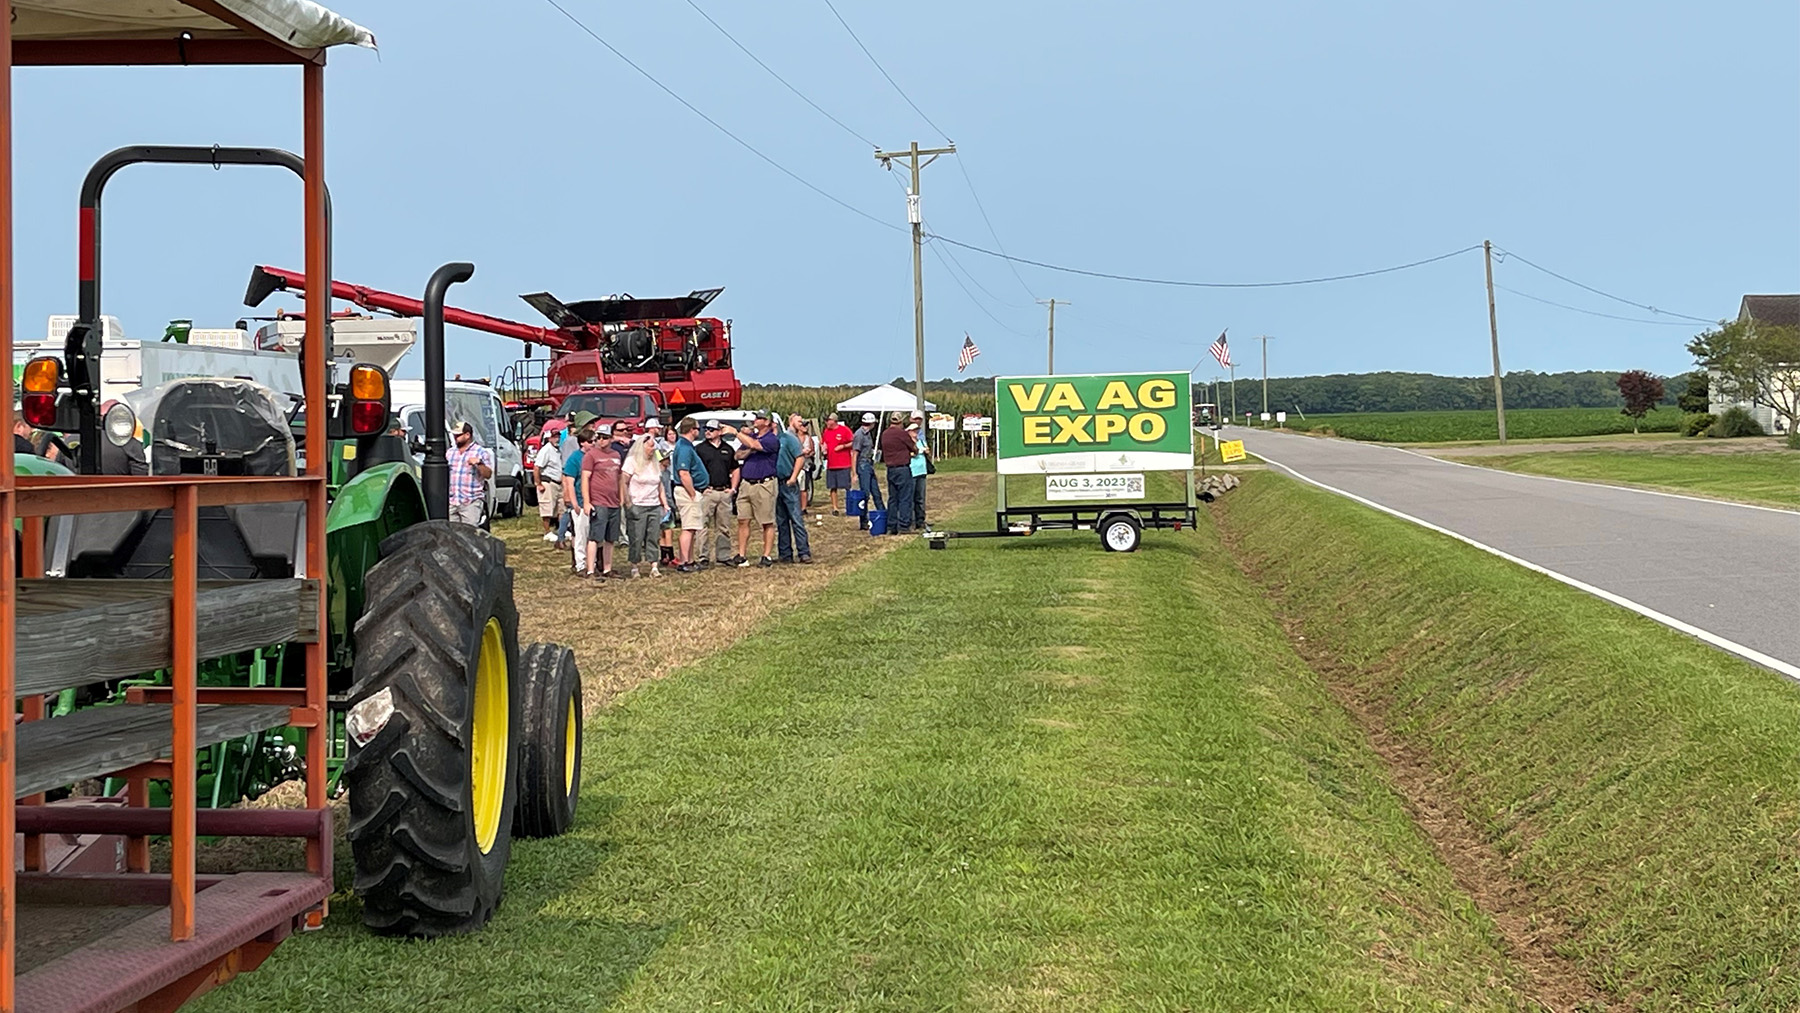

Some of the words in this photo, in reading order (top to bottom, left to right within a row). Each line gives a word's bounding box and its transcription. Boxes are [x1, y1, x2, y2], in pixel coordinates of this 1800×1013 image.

[700, 391, 722, 399] CASE
[1008, 382, 1085, 412] VA
[1096, 379, 1176, 410] AG
[1023, 412, 1167, 445] EXPO
[1048, 479, 1079, 488] AUG
[1082, 478, 1094, 488] 3,
[1096, 477, 1126, 487] 2023
